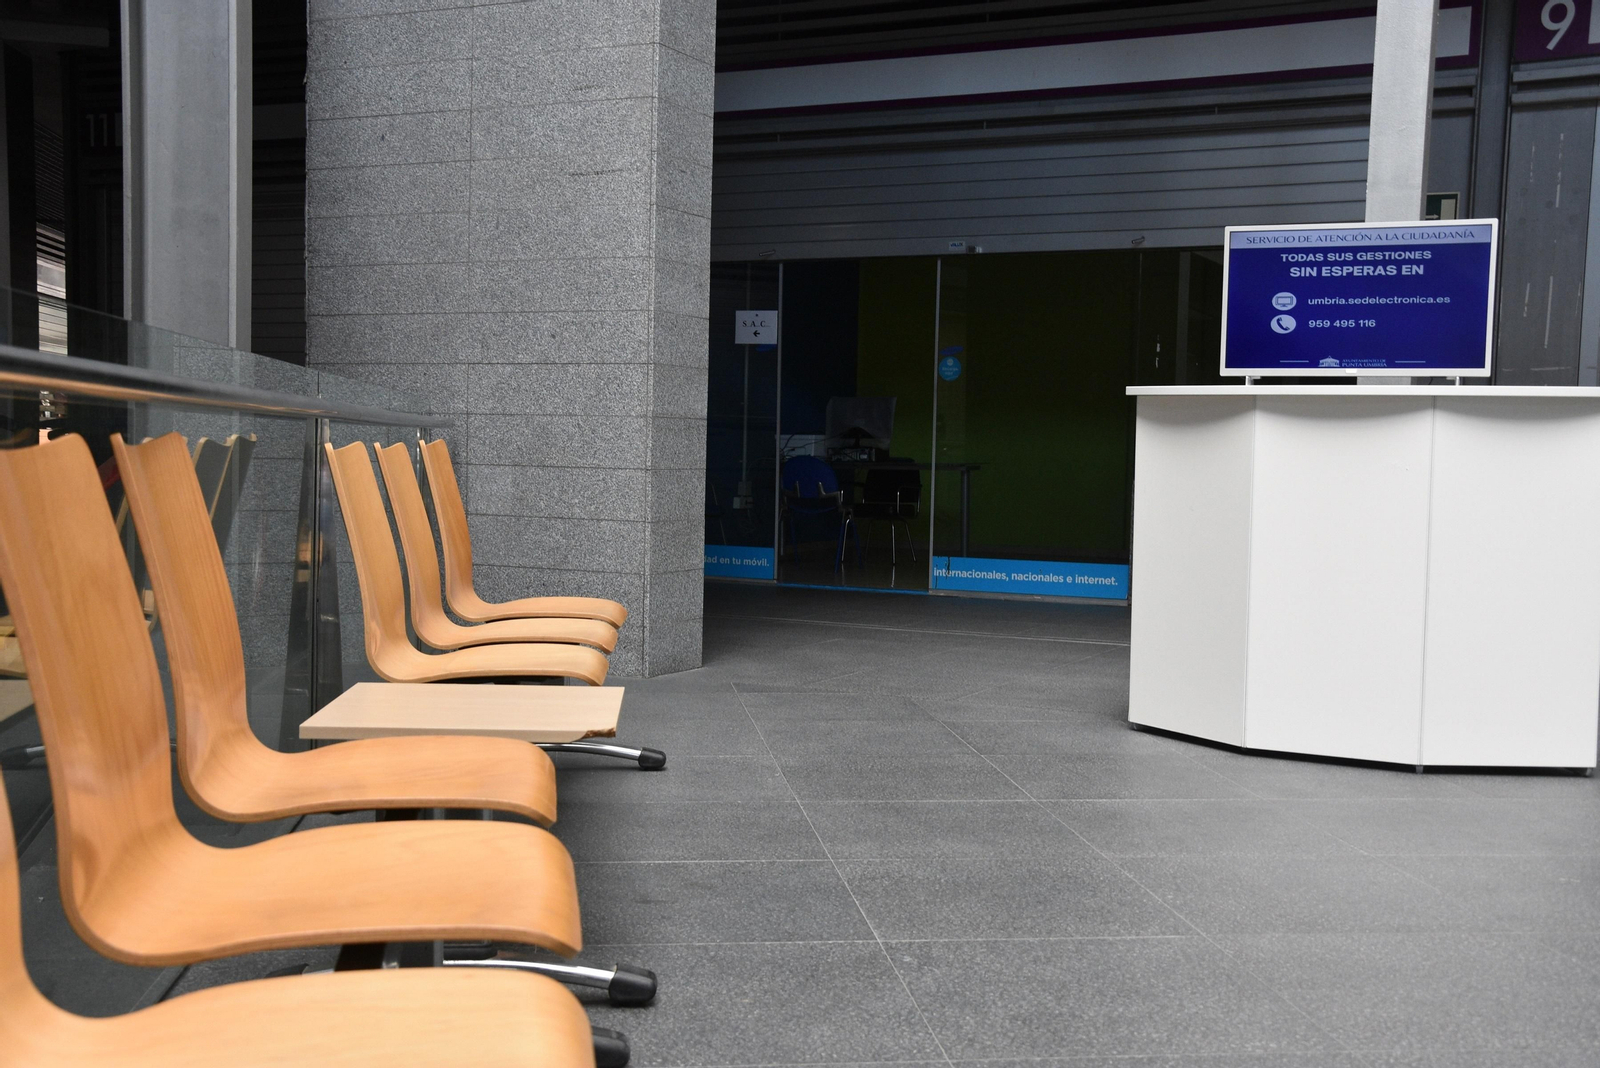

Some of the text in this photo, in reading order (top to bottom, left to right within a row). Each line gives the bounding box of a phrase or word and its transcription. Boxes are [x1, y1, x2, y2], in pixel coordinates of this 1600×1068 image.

[1540, 0, 1576, 50] 9
[85, 113, 108, 147] 11
[1246, 229, 1475, 245] SERVICIO DE ATENCIÓN A LA CIUDADANÍA
[1280, 250, 1432, 262] TODAS SUS GESTIONES
[1289, 264, 1424, 278] SIN ESPERAS EN
[1308, 296, 1451, 305] umbria.sedelectronica.es
[1308, 319, 1376, 328] 959 495 116
[719, 557, 730, 565] en
[732, 556, 741, 565] tu
[743, 557, 770, 567] móvil.
[933, 567, 1118, 586] internacionales, nacionales e internet.
